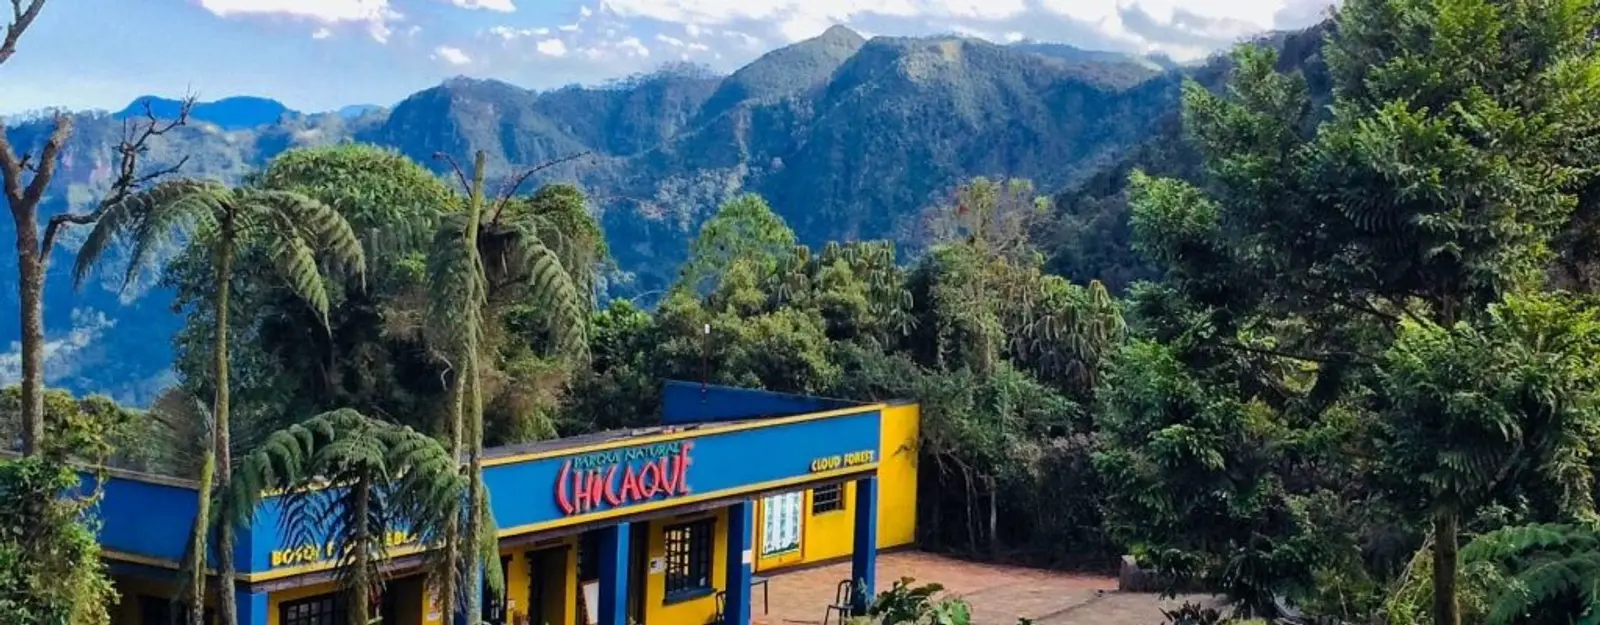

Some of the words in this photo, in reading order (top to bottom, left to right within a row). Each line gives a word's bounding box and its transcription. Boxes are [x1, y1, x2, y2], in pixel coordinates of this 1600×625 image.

[574, 454, 620, 469] PARQUE
[625, 442, 680, 461] NATURAL
[811, 456, 841, 471] CLOUD
[844, 450, 874, 467] FOREST
[557, 441, 692, 515] CHICAQUE
